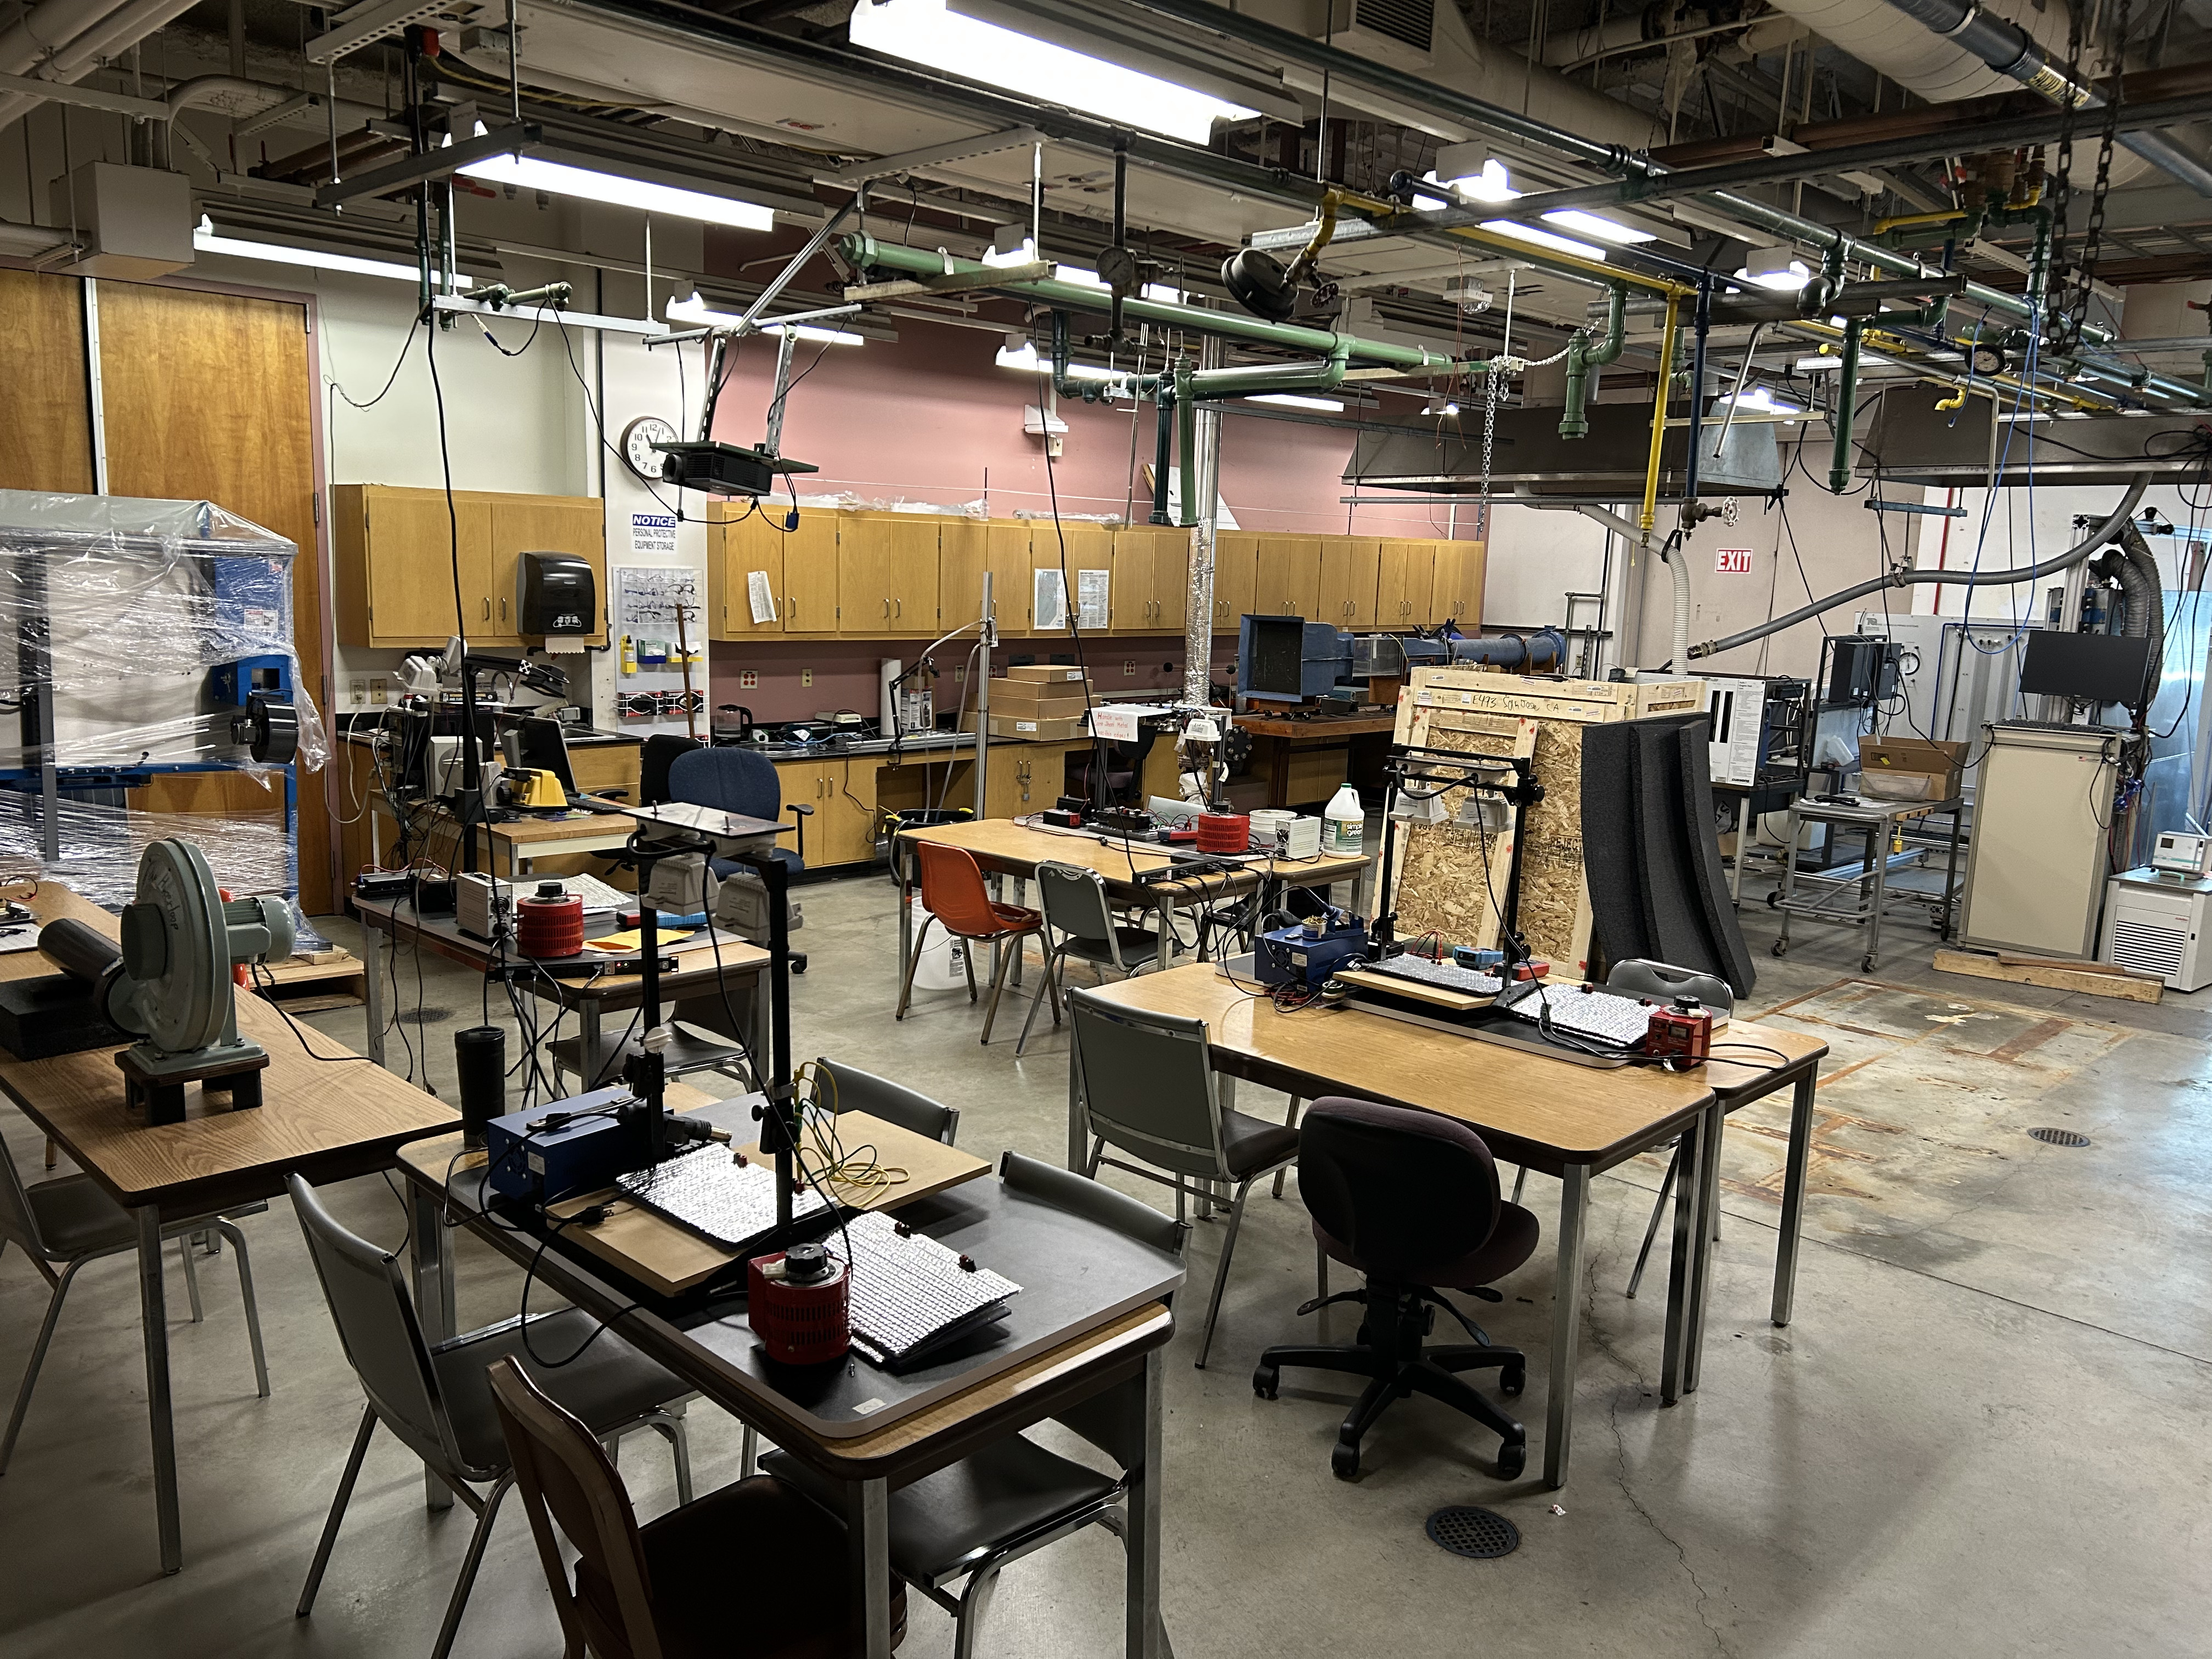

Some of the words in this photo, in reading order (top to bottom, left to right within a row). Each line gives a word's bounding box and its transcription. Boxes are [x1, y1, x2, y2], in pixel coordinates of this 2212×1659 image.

[633, 516, 675, 527] NOTICE
[633, 528, 653, 537] PERSONAL
[653, 529, 676, 538] PROTECTIVE
[635, 540, 656, 549] EQUIPMENT
[657, 541, 674, 550] STORAGE
[1717, 551, 1751, 571] EXIT
[1472, 695, 1497, 708] E493
[1547, 703, 1559, 713] CA
